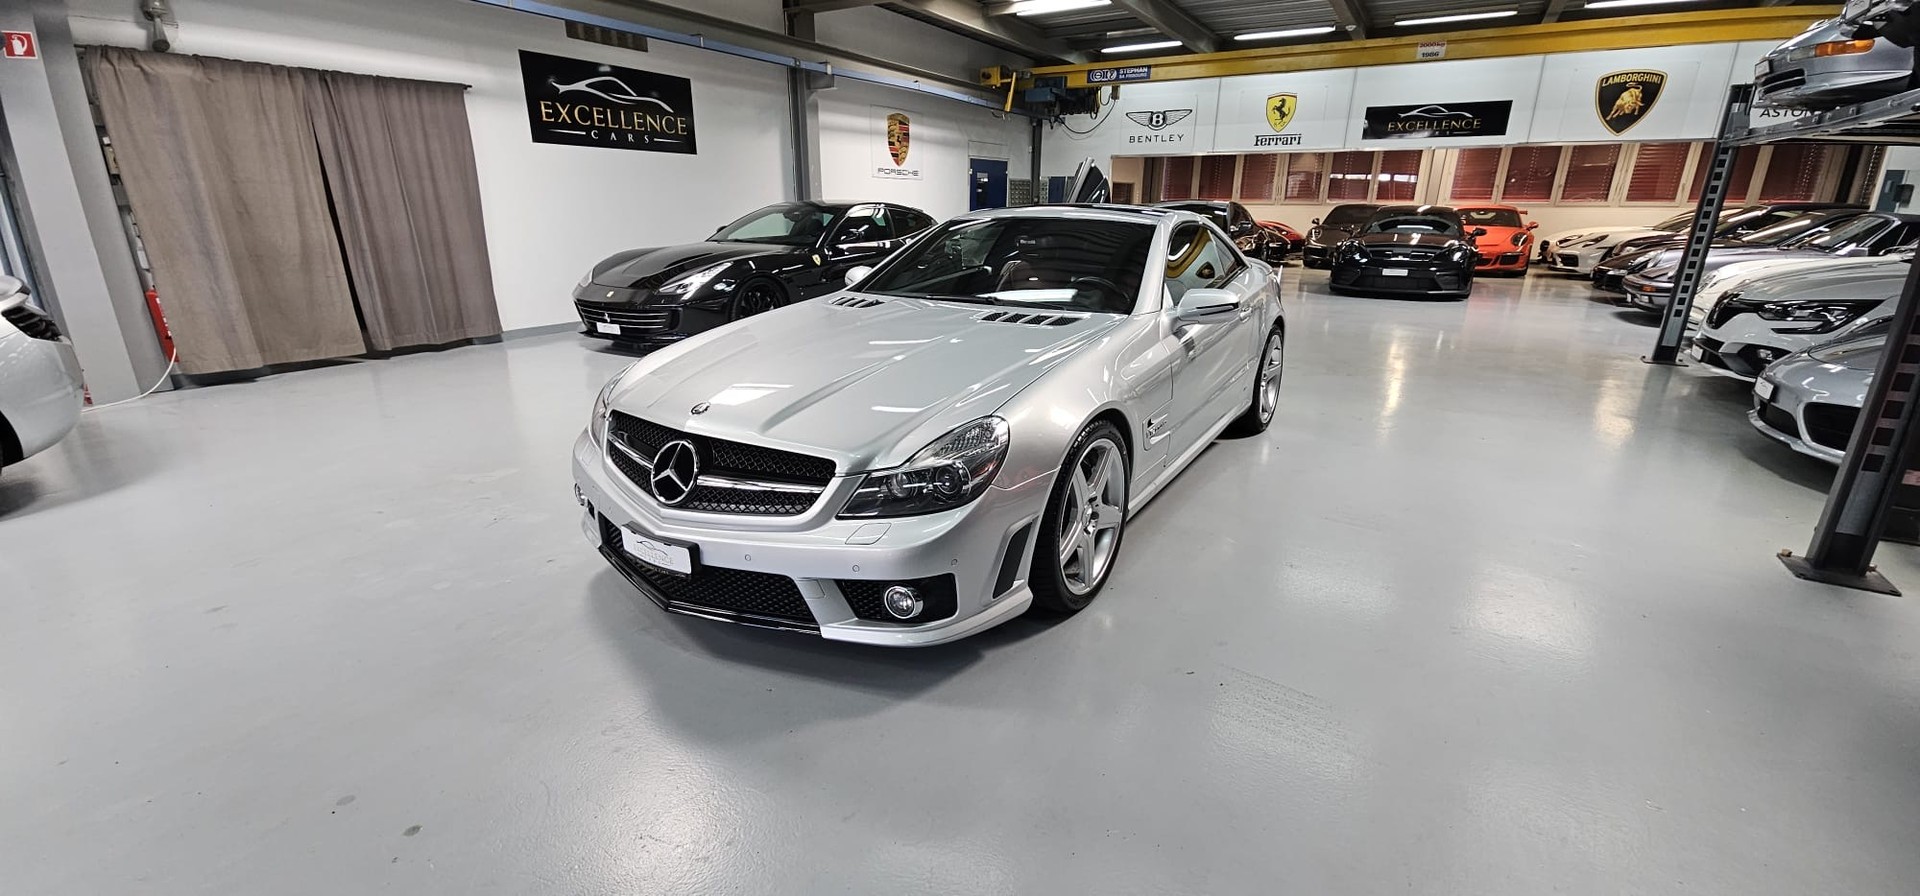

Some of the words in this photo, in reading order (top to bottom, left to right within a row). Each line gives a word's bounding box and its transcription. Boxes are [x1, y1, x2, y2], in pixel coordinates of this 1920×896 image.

[1119, 66, 1148, 74] STEPHAN
[1602, 73, 1662, 87] LAMBORGHINI
[540, 101, 688, 135] EXCELLENCE
[1387, 118, 1482, 132] EXCELLENCE
[591, 130, 649, 144] CARS
[1129, 134, 1185, 144] BENTLEY
[1253, 133, 1302, 147] Ferrari
[877, 168, 920, 177] PORSCHE
